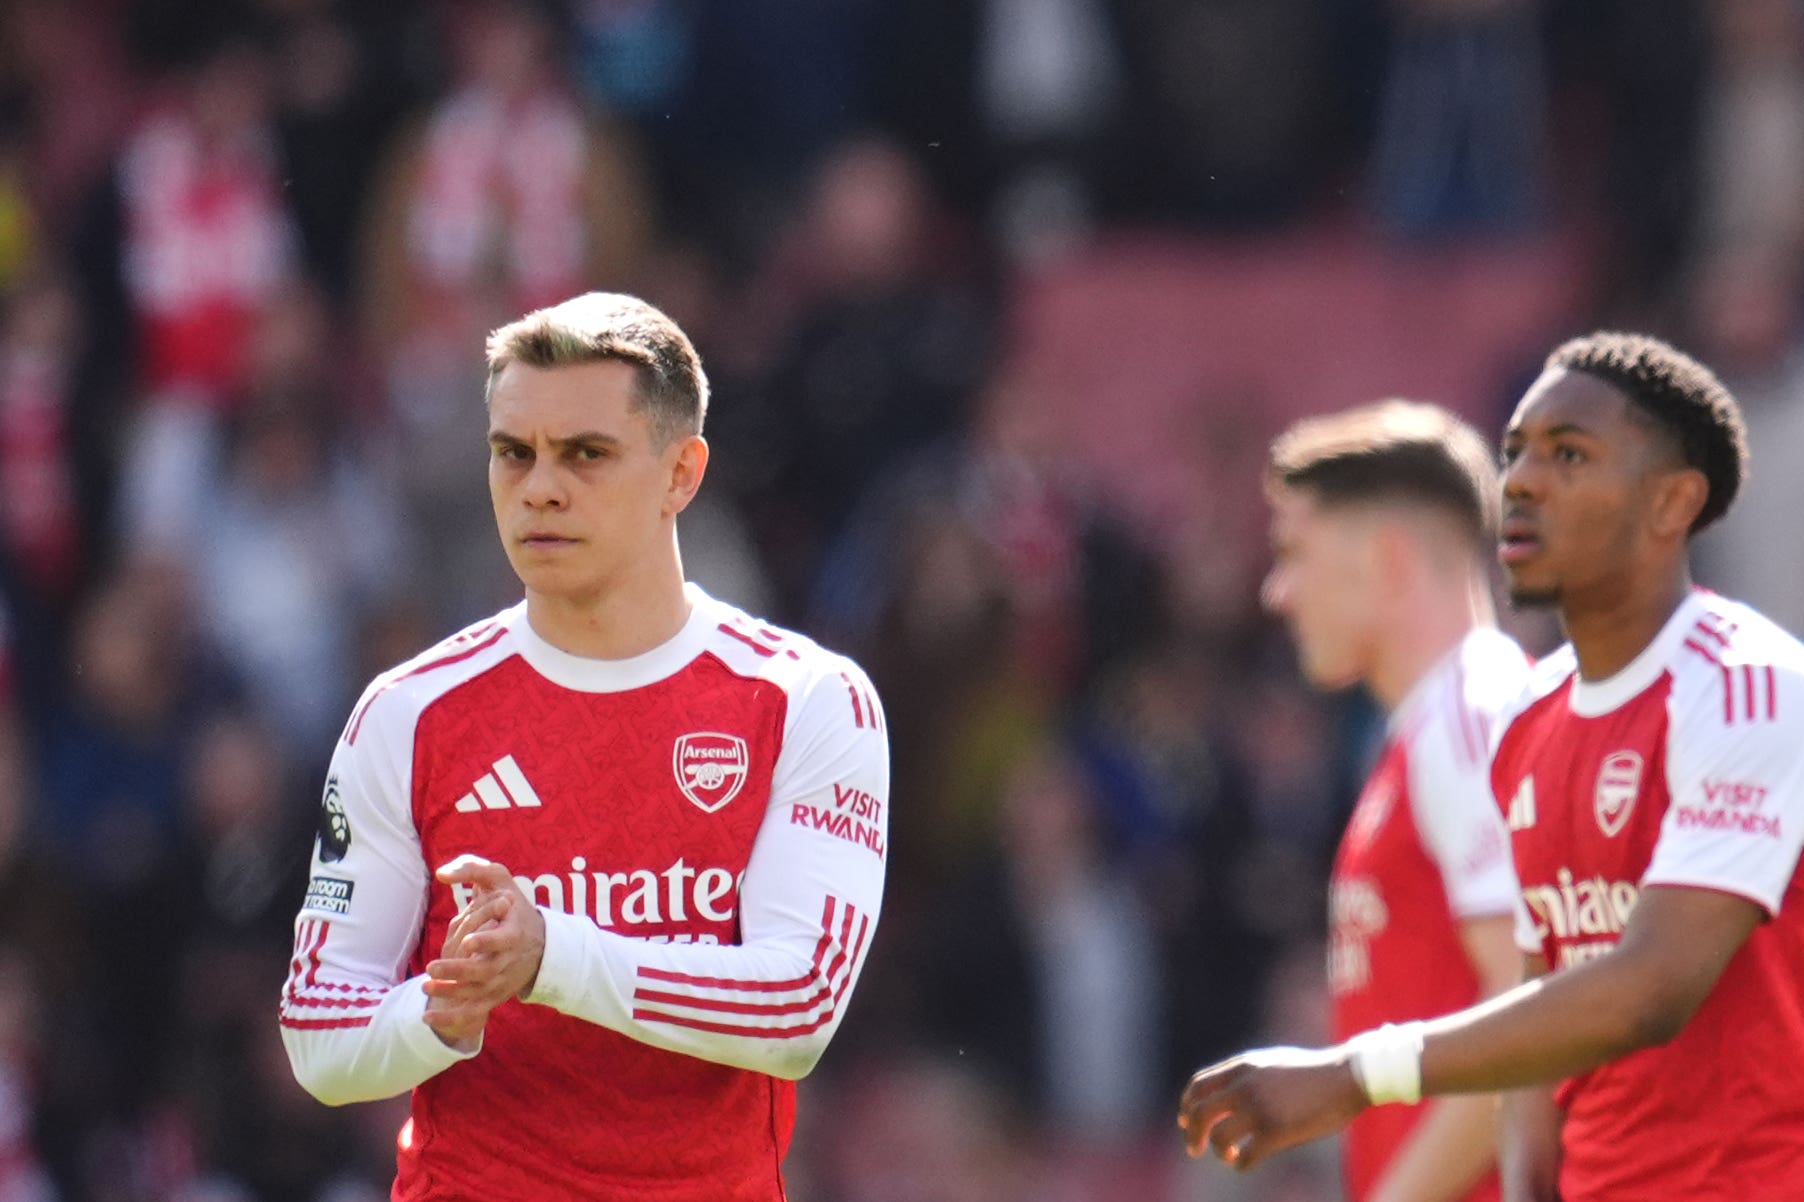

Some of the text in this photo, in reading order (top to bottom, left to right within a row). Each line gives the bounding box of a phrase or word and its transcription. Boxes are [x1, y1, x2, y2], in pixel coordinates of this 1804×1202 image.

[684, 745, 737, 759] Arsenal
[833, 783, 881, 825] VISIT
[790, 803, 885, 860] RWAND
